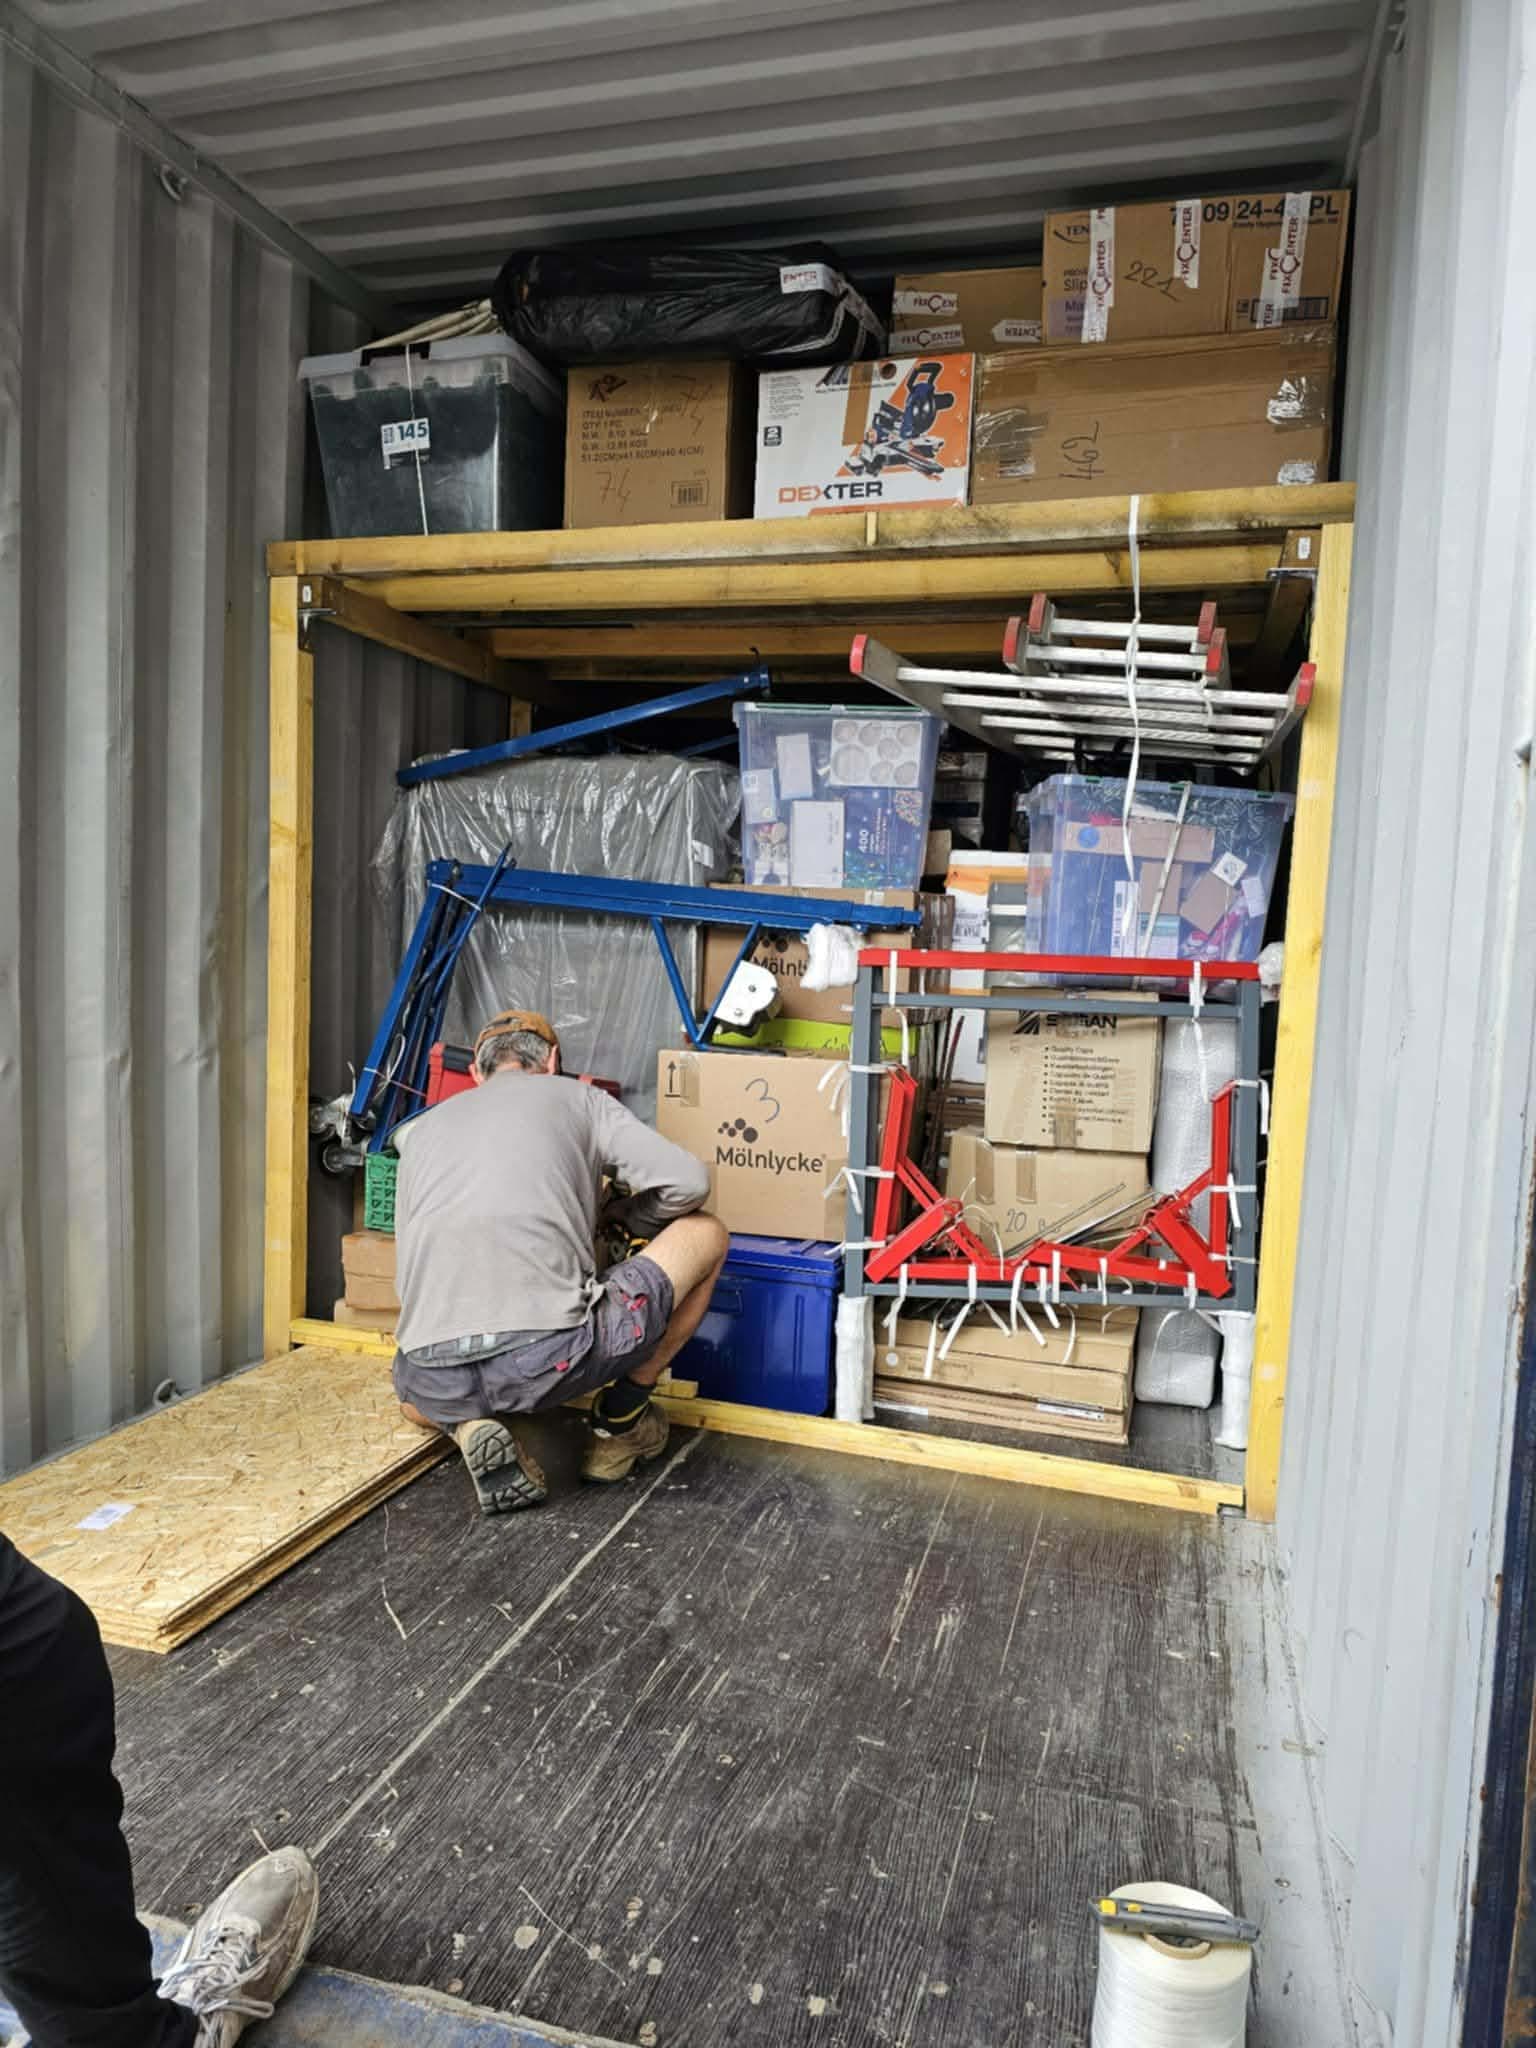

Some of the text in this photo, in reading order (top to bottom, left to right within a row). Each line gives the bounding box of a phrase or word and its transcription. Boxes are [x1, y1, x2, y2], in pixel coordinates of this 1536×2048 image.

[1237, 198, 1286, 220] 24-4
[1310, 195, 1340, 216] PL
[1066, 224, 1090, 236] TEN
[398, 420, 428, 441] 145
[778, 481, 883, 504] DEXTER
[745, 1078, 780, 1123] 3
[716, 1146, 823, 1176] Mölnlycke
